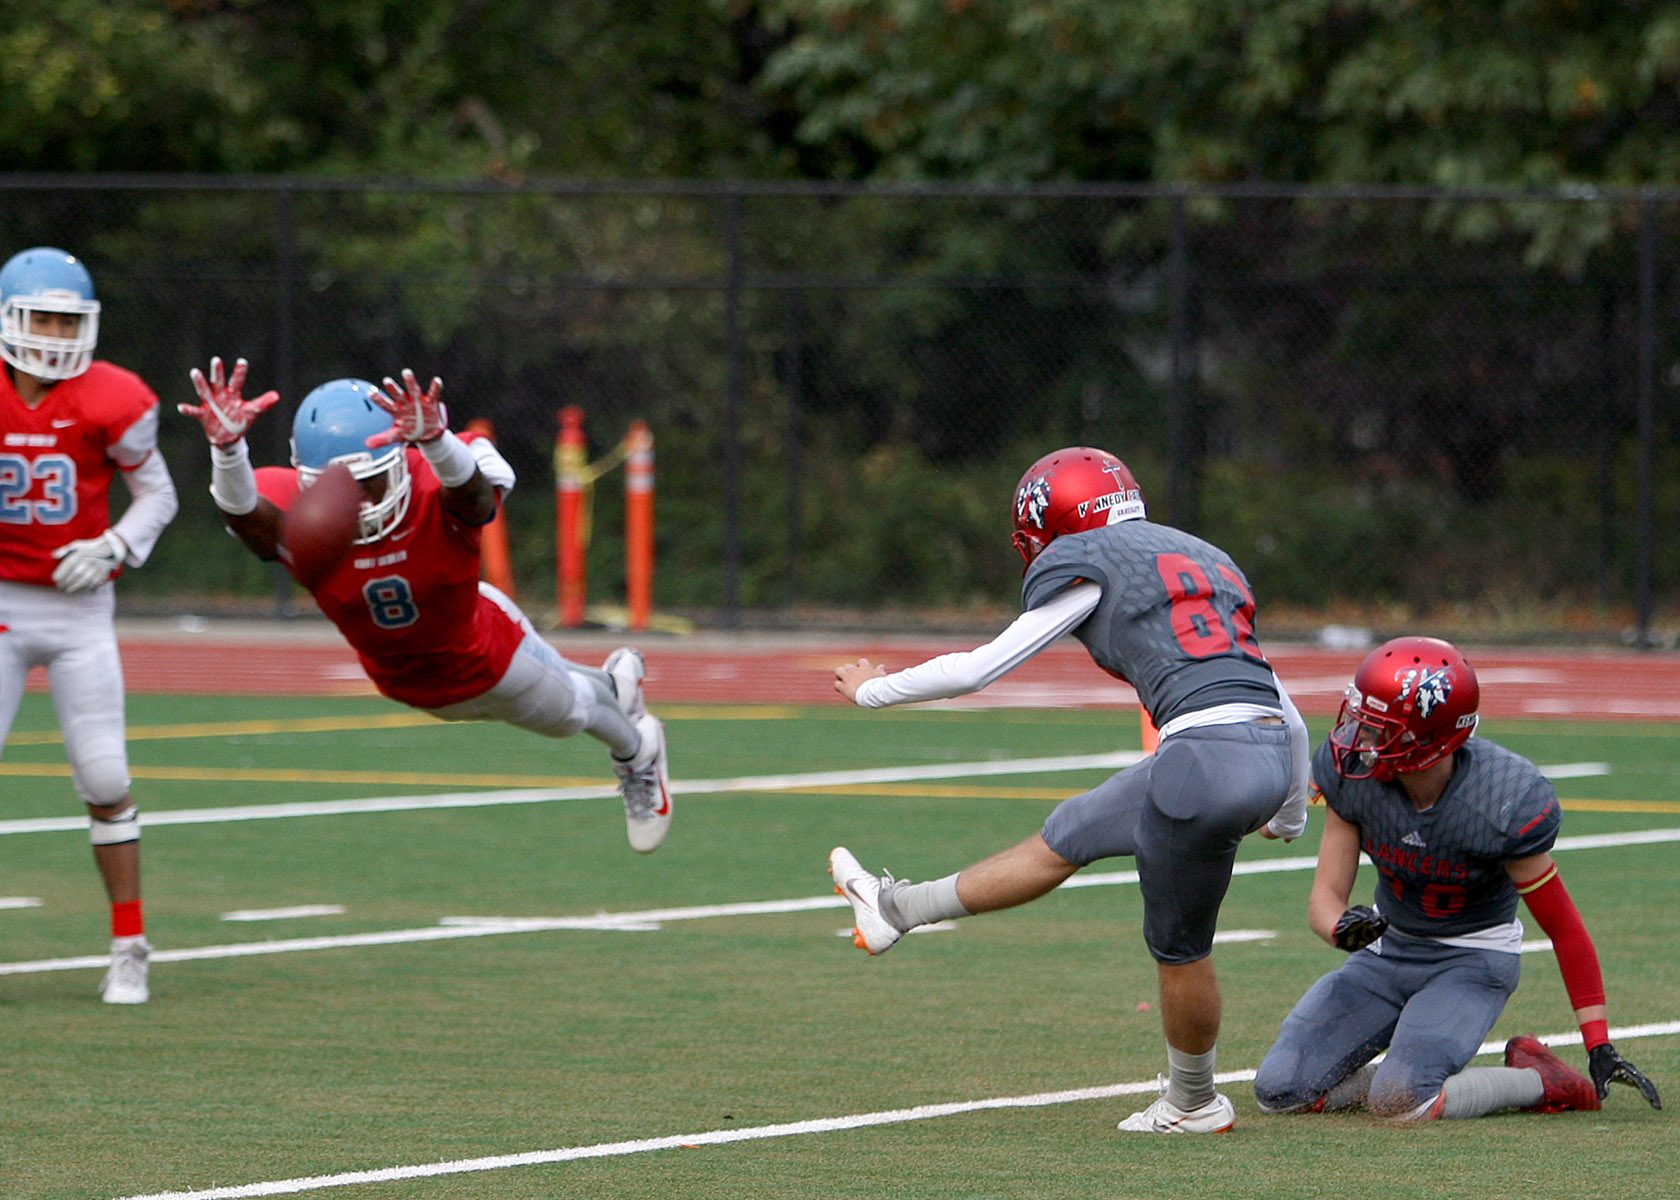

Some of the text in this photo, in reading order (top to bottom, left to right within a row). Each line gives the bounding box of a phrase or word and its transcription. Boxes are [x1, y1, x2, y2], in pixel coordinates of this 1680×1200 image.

[0, 453, 78, 525] 23
[362, 574, 420, 629] 8
[1366, 839, 1468, 879] LANCERS
